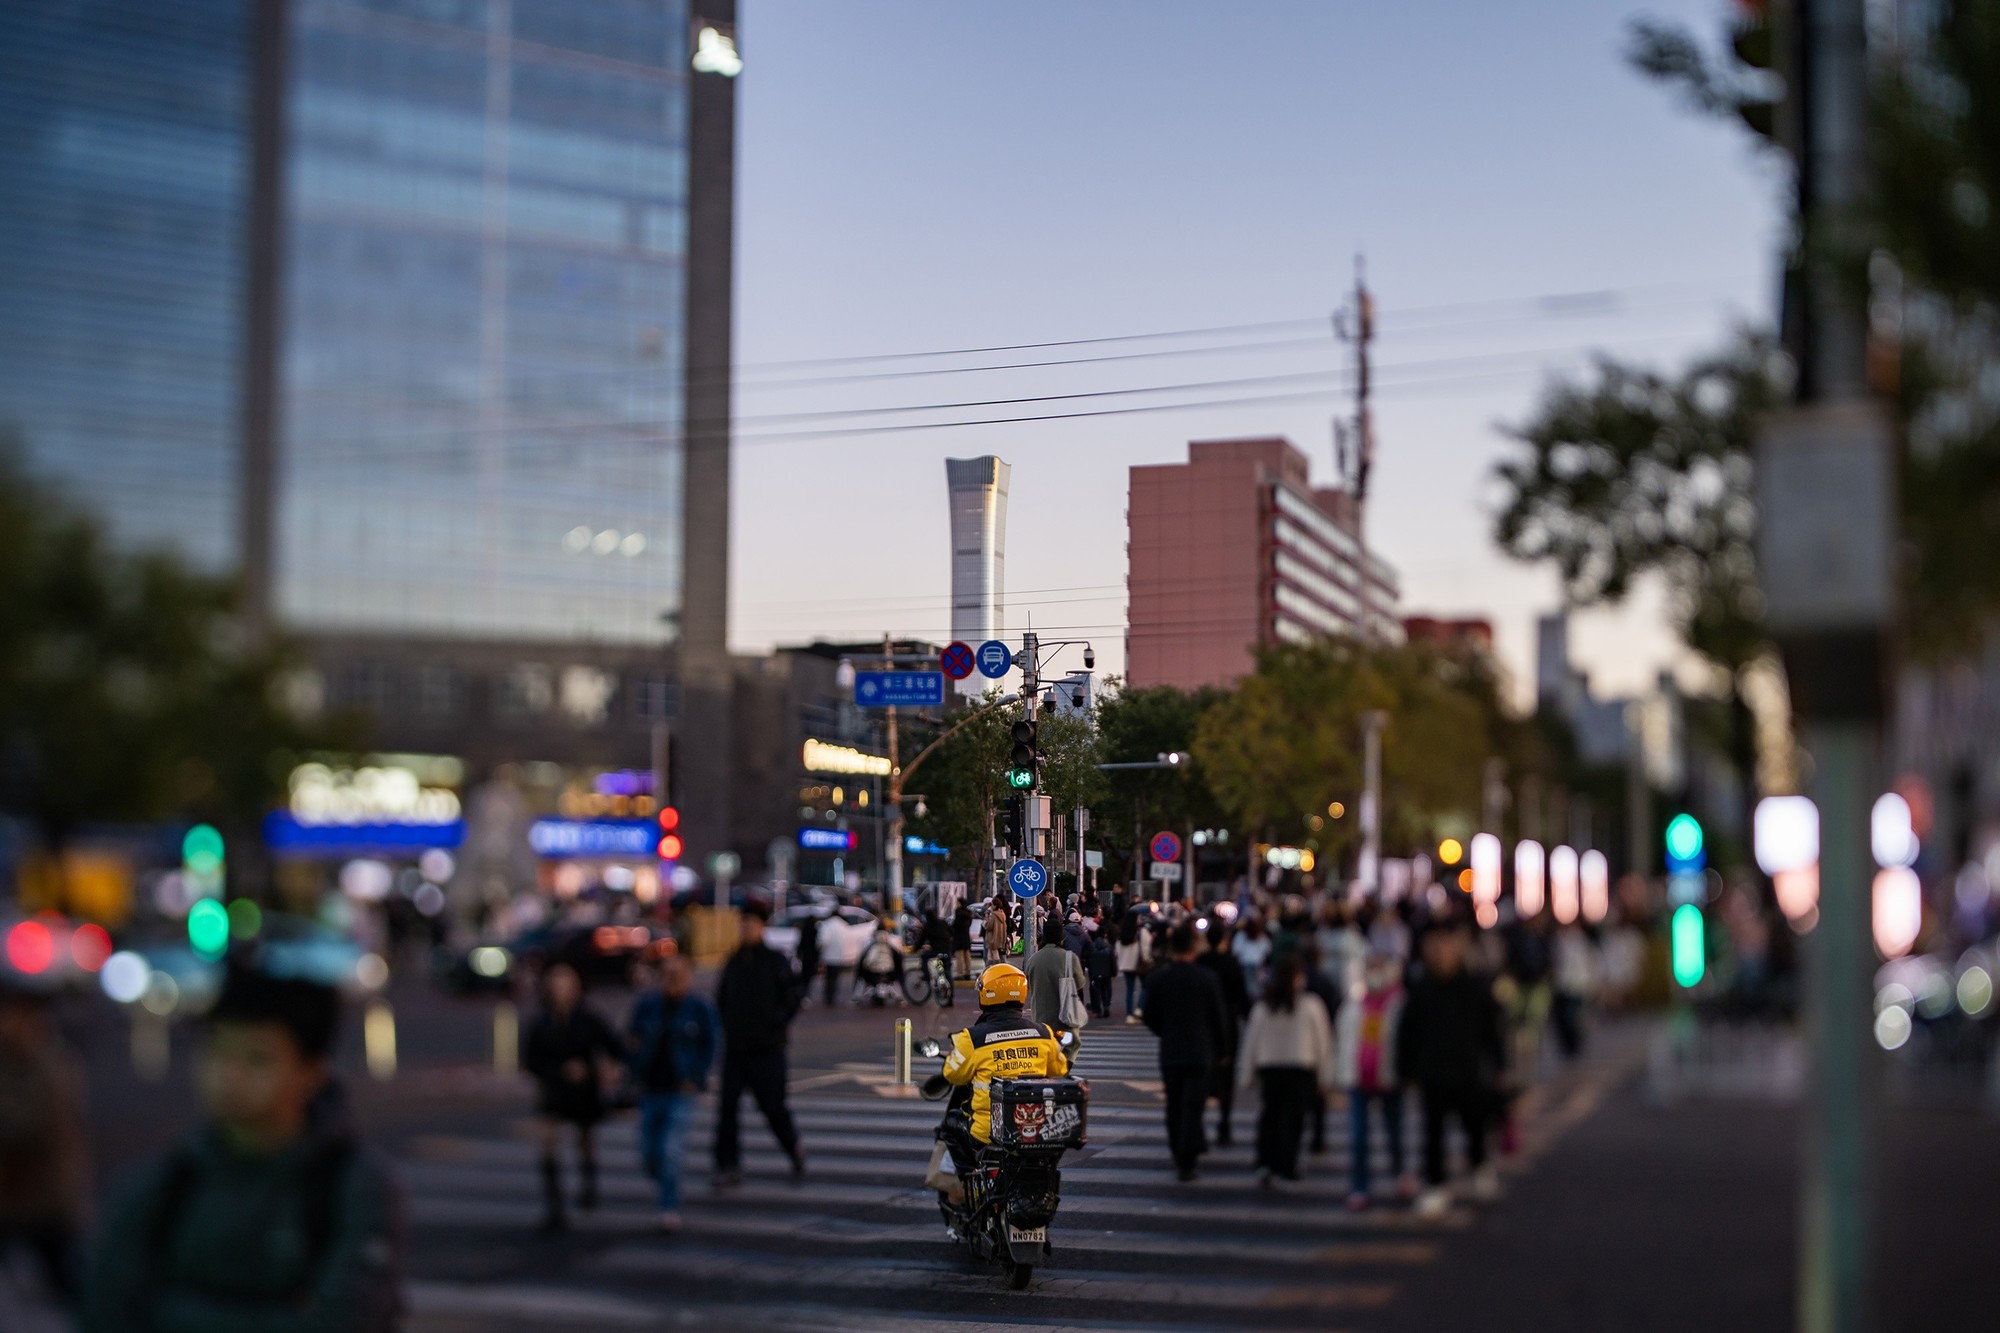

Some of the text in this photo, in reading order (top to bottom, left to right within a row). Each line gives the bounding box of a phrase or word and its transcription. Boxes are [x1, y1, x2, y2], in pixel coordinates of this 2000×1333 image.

[992, 1046, 1039, 1062] 美食团购
[995, 1061, 1033, 1072] 上美团App
[1012, 1232, 1044, 1241] NN0782
